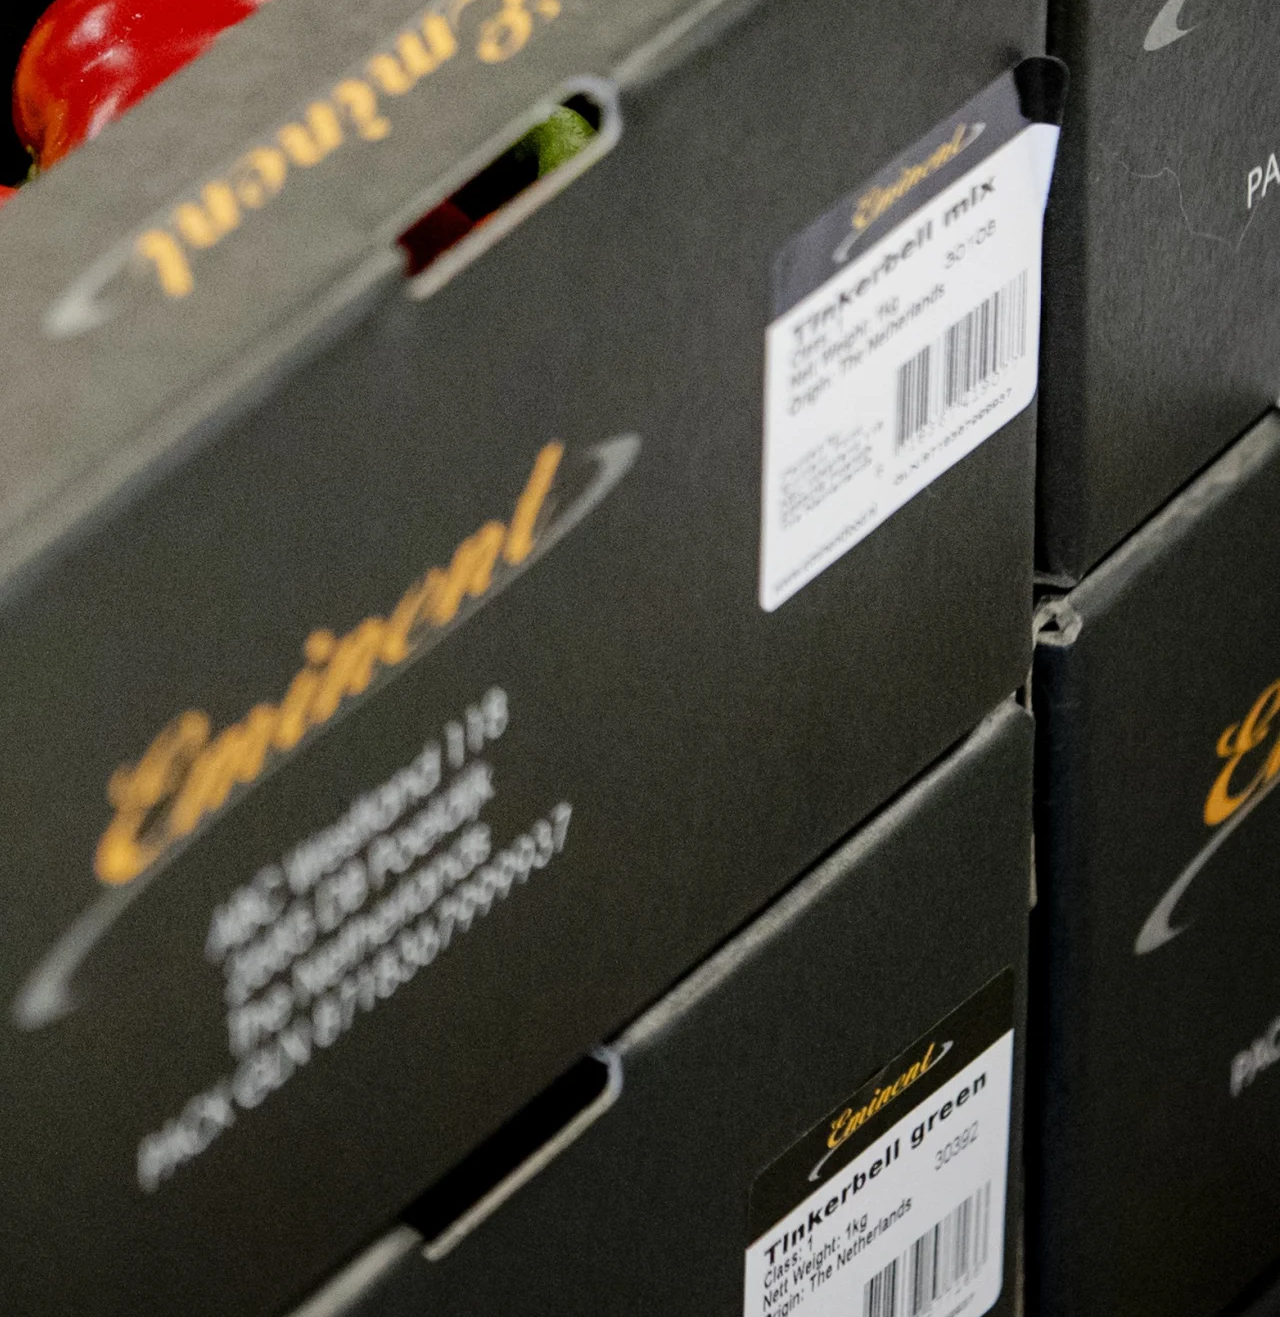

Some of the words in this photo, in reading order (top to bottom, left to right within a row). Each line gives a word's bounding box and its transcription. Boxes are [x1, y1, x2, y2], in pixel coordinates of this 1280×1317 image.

[851, 123, 966, 230] Eminent
[942, 176, 996, 227] mix
[95, 441, 565, 883] Eminent
[827, 1041, 936, 1150] Eminent
[763, 1137, 900, 1267] Tinkerbell
[911, 1072, 987, 1150] green
[935, 1120, 980, 1171] 30392
[763, 1279, 789, 1312] Nett
[793, 1236, 841, 1286] Weight:
[846, 1214, 868, 1240] 1kg
[764, 1249, 802, 1290] Class:
[807, 1234, 814, 1252] 1
[810, 1264, 832, 1292] The
[837, 1197, 912, 1272] Netherlands
